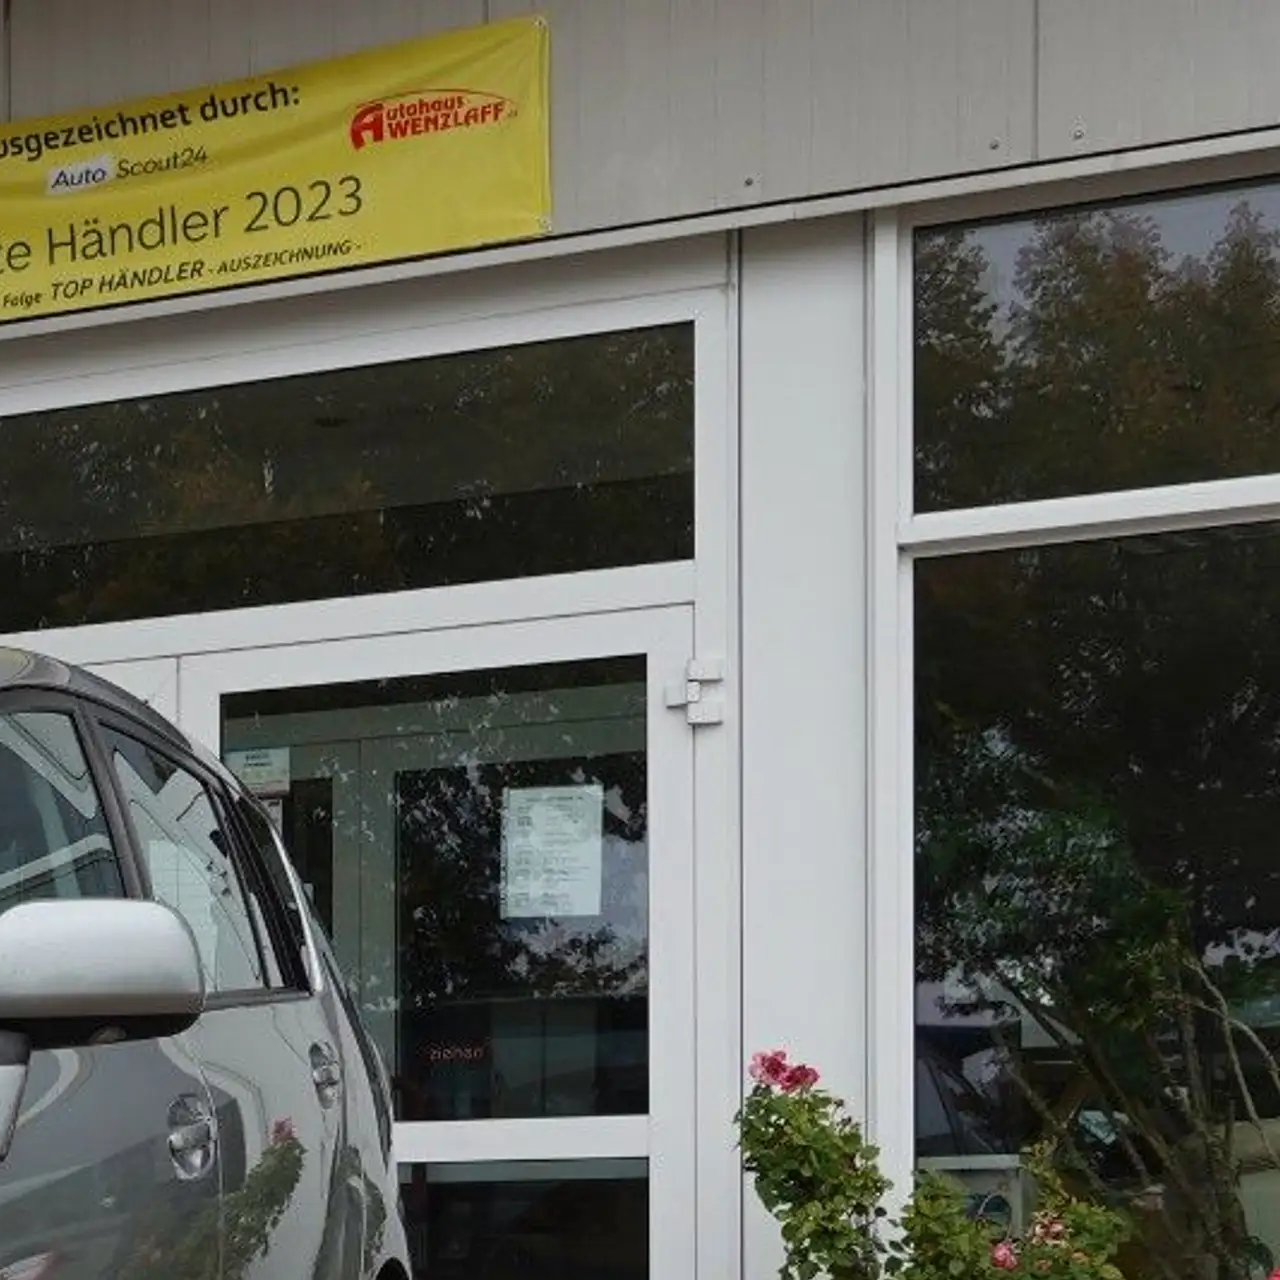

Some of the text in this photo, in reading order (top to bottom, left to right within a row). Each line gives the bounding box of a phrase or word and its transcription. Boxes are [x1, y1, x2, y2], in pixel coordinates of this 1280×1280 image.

[199, 81, 300, 123] durch:
[388, 101, 505, 139] WENZLAFF
[50, 146, 208, 189] Auto Scout24
[46, 204, 230, 266] Händler
[243, 174, 363, 233] 2023
[3, 292, 42, 309] Folge
[50, 276, 93, 300] TOP
[98, 259, 205, 293] HÄNDLER
[216, 239, 352, 275] AUSZEICHNUNG
